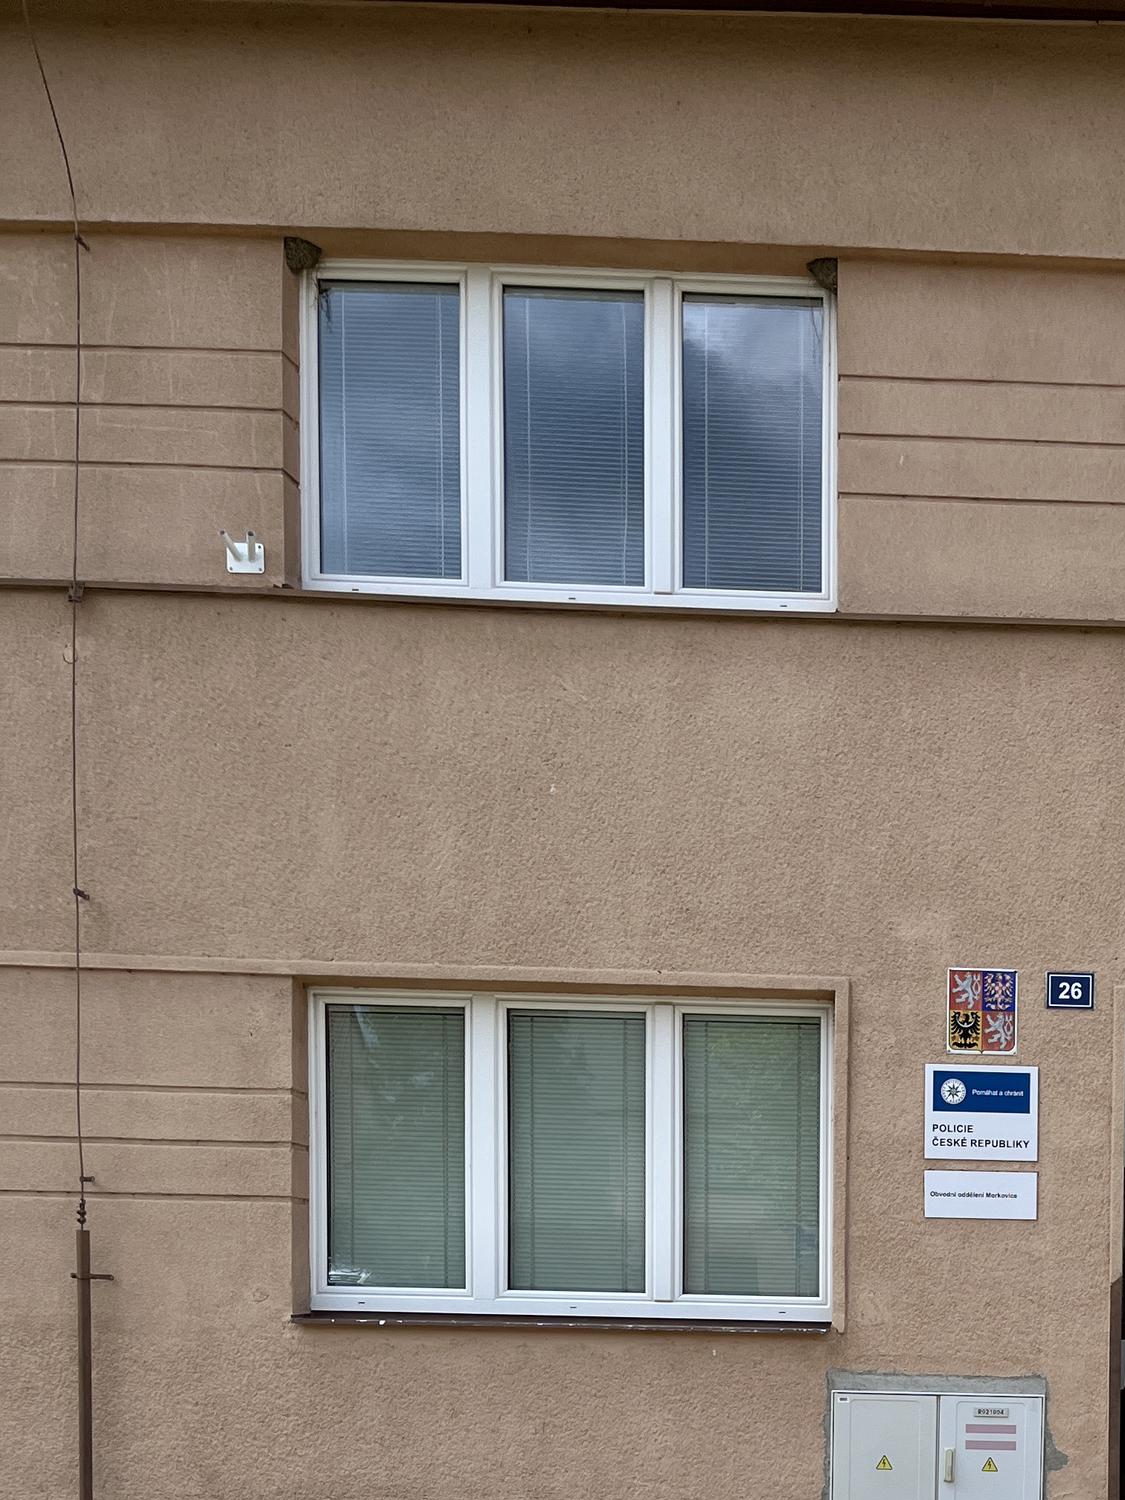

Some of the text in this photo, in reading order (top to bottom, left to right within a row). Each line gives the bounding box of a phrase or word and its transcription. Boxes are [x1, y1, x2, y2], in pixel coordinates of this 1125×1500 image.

[1058, 981, 1082, 1000] 26
[971, 1088, 998, 1097] Pomáhat
[1004, 1090, 1024, 1098] chránit
[932, 1123, 974, 1134] POLICIE
[932, 1136, 1030, 1149] ČESKÉ REPUBLIKY
[929, 1190, 957, 1198] Obvodní
